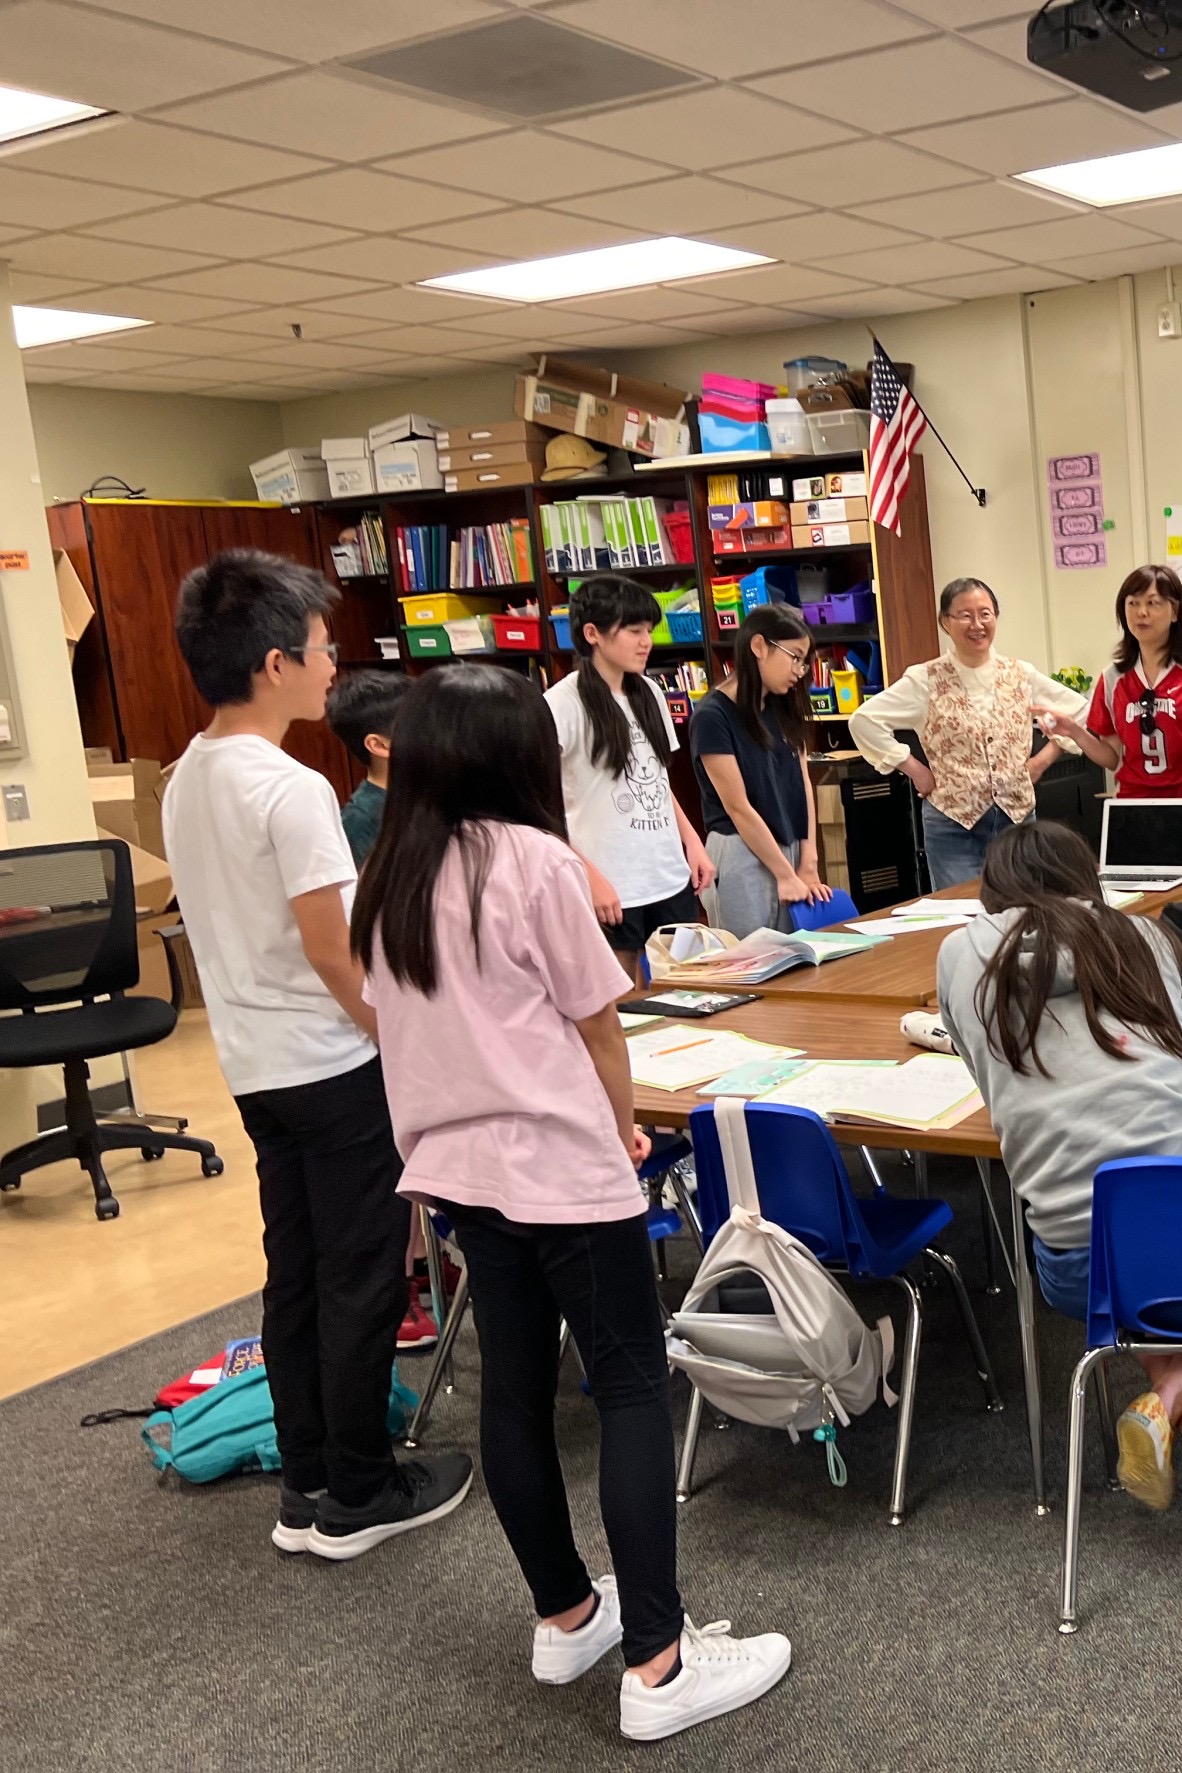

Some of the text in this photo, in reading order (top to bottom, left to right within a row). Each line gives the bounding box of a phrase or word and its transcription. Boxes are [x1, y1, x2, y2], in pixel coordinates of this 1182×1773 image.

[723, 616, 732, 624] 21
[816, 700, 826, 709] 19
[673, 705, 682, 713] 14
[1141, 728, 1168, 775] 9
